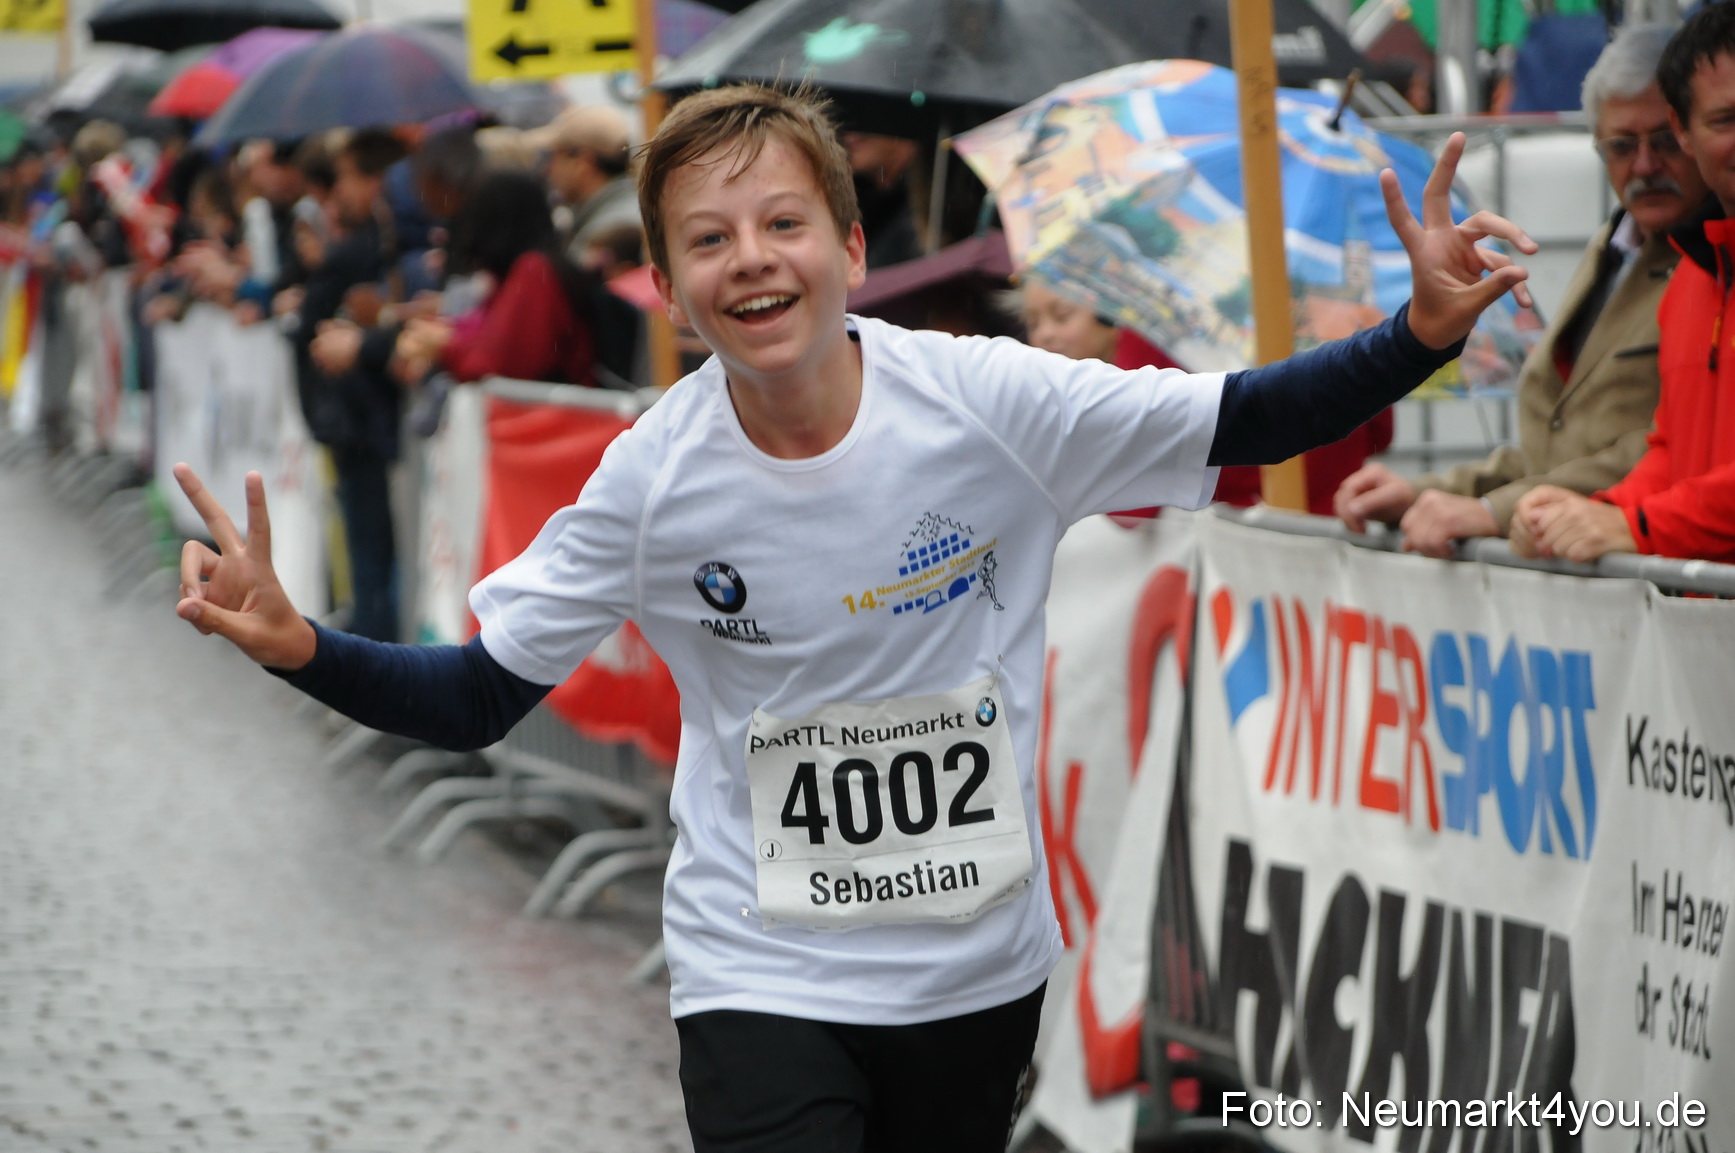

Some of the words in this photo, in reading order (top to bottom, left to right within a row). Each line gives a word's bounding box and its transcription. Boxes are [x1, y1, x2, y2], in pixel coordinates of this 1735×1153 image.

[694, 562, 738, 583] BMW
[841, 589, 885, 615] 14.
[876, 566, 946, 597] Neumarkter
[948, 536, 998, 569] Stadtlauf
[750, 725, 834, 754] PARTL
[841, 712, 965, 746] Neumarkt
[1262, 592, 1598, 863] INTERSPORT
[781, 741, 996, 845] 4002
[766, 843, 775, 859] J
[810, 859, 980, 906] Sebastian
